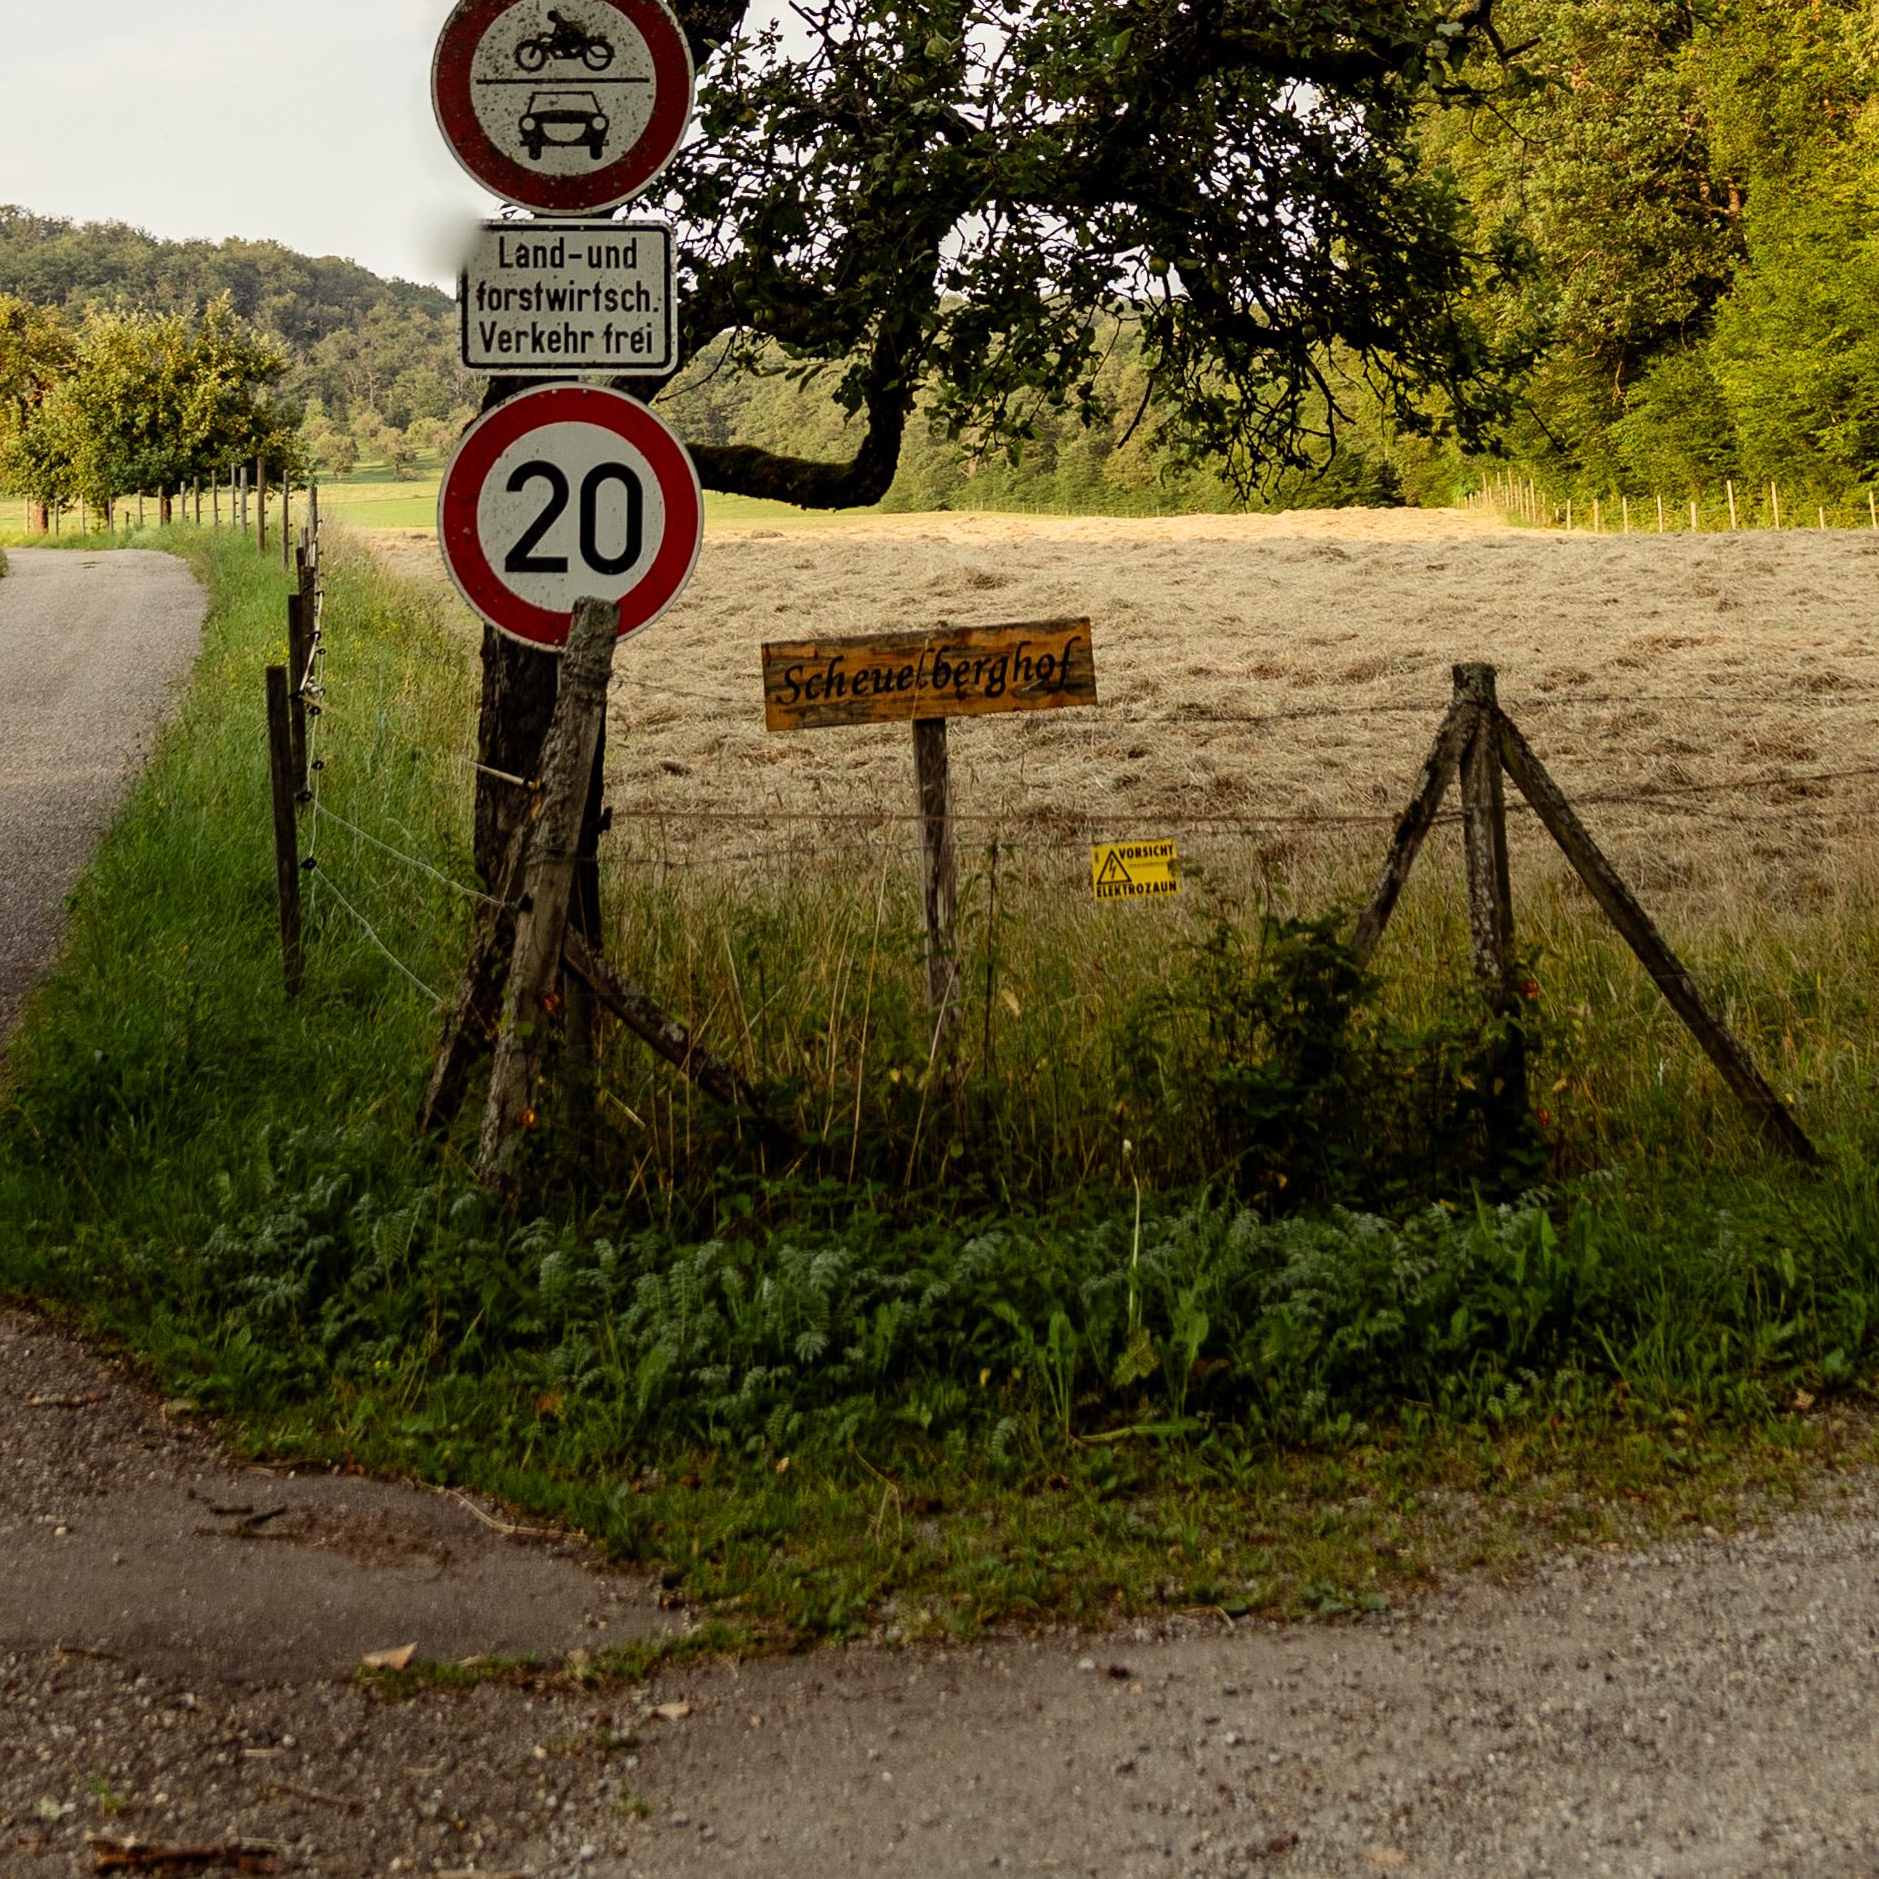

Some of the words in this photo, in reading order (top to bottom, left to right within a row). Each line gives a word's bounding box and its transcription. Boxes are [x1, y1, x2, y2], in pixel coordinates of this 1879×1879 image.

[476, 280, 659, 312] forstwirtsch.
[479, 321, 594, 353] Verkehr
[602, 322, 652, 354] frei
[504, 460, 643, 575] 20
[776, 636, 1082, 705] Scheuelberghof
[1119, 844, 1173, 859] VORSICHT
[1096, 881, 1177, 898] ELEKTROZAUN
